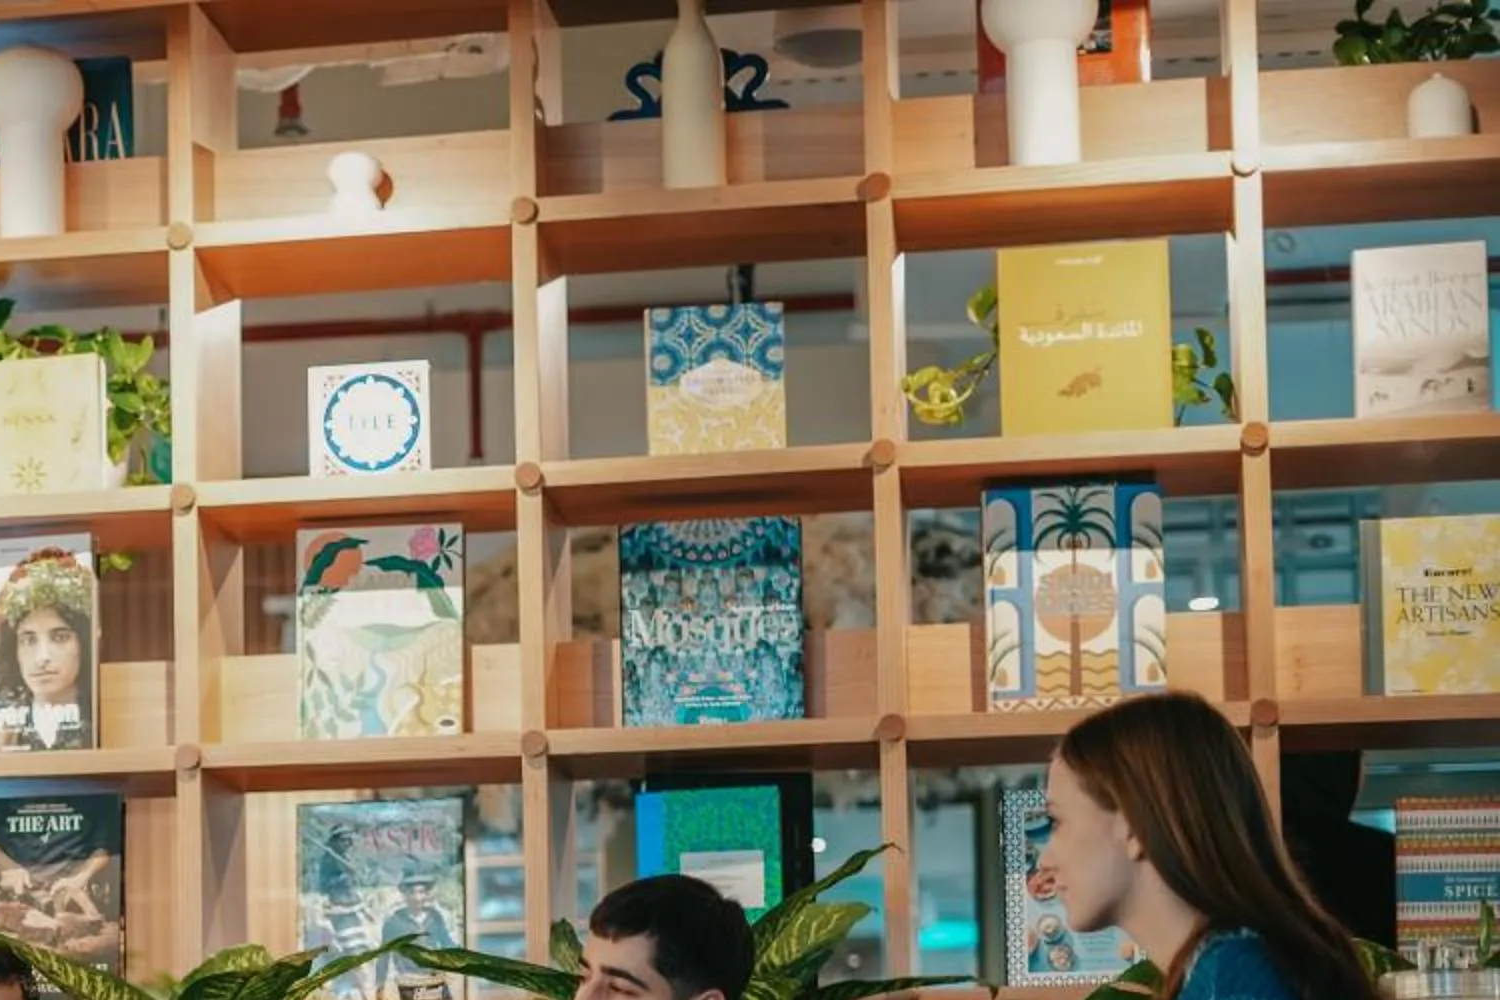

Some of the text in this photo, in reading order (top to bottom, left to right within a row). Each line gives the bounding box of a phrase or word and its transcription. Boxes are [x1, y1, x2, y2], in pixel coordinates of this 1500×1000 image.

[1366, 286, 1482, 317] ARABIAN
[1396, 583, 1500, 603] THE NEW
[1396, 602, 1500, 625] ARTISANS
[627, 608, 802, 653] Mosques
[6, 813, 84, 834] THE ART
[1444, 884, 1498, 898] SPICE
